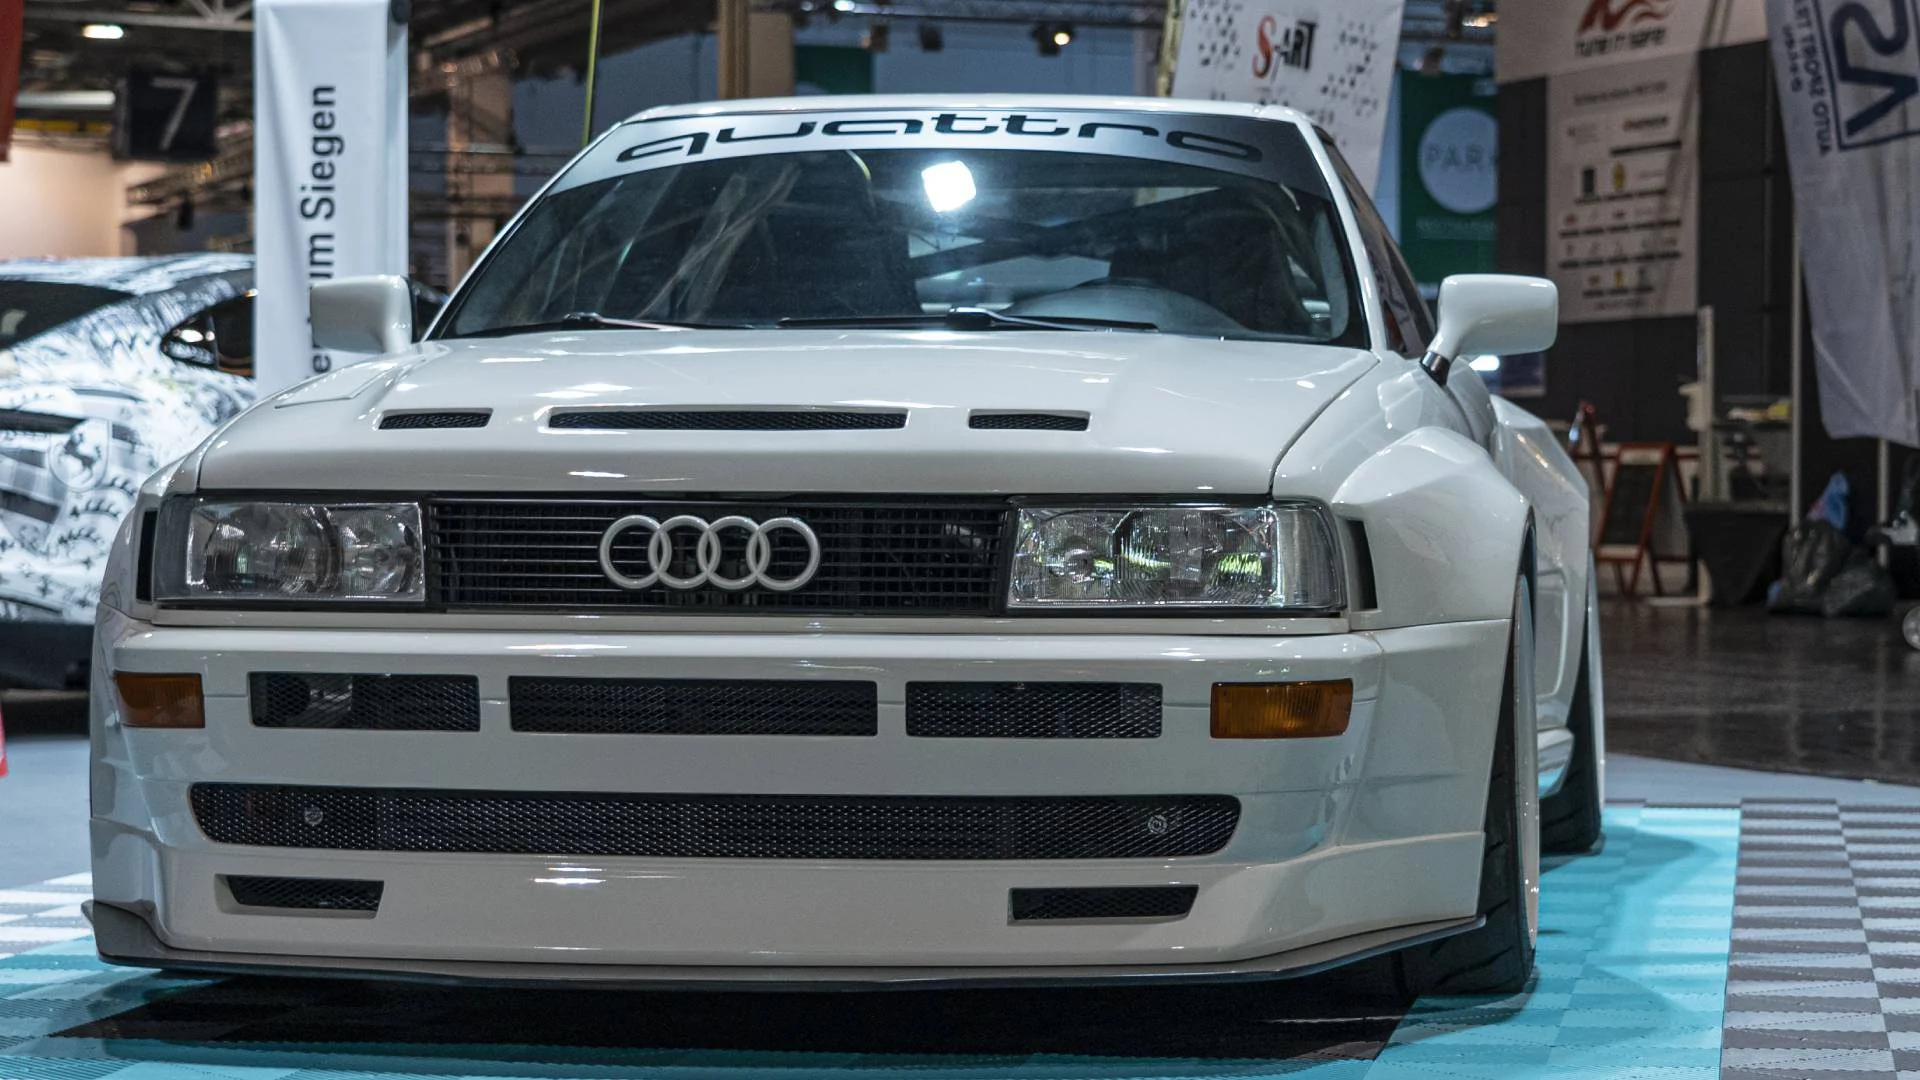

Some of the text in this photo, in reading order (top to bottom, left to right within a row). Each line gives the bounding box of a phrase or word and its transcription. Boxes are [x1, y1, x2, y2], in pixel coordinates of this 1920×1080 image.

[149, 78, 198, 151] 7
[616, 112, 1263, 163] quattro
[300, 84, 345, 220] Siegen
